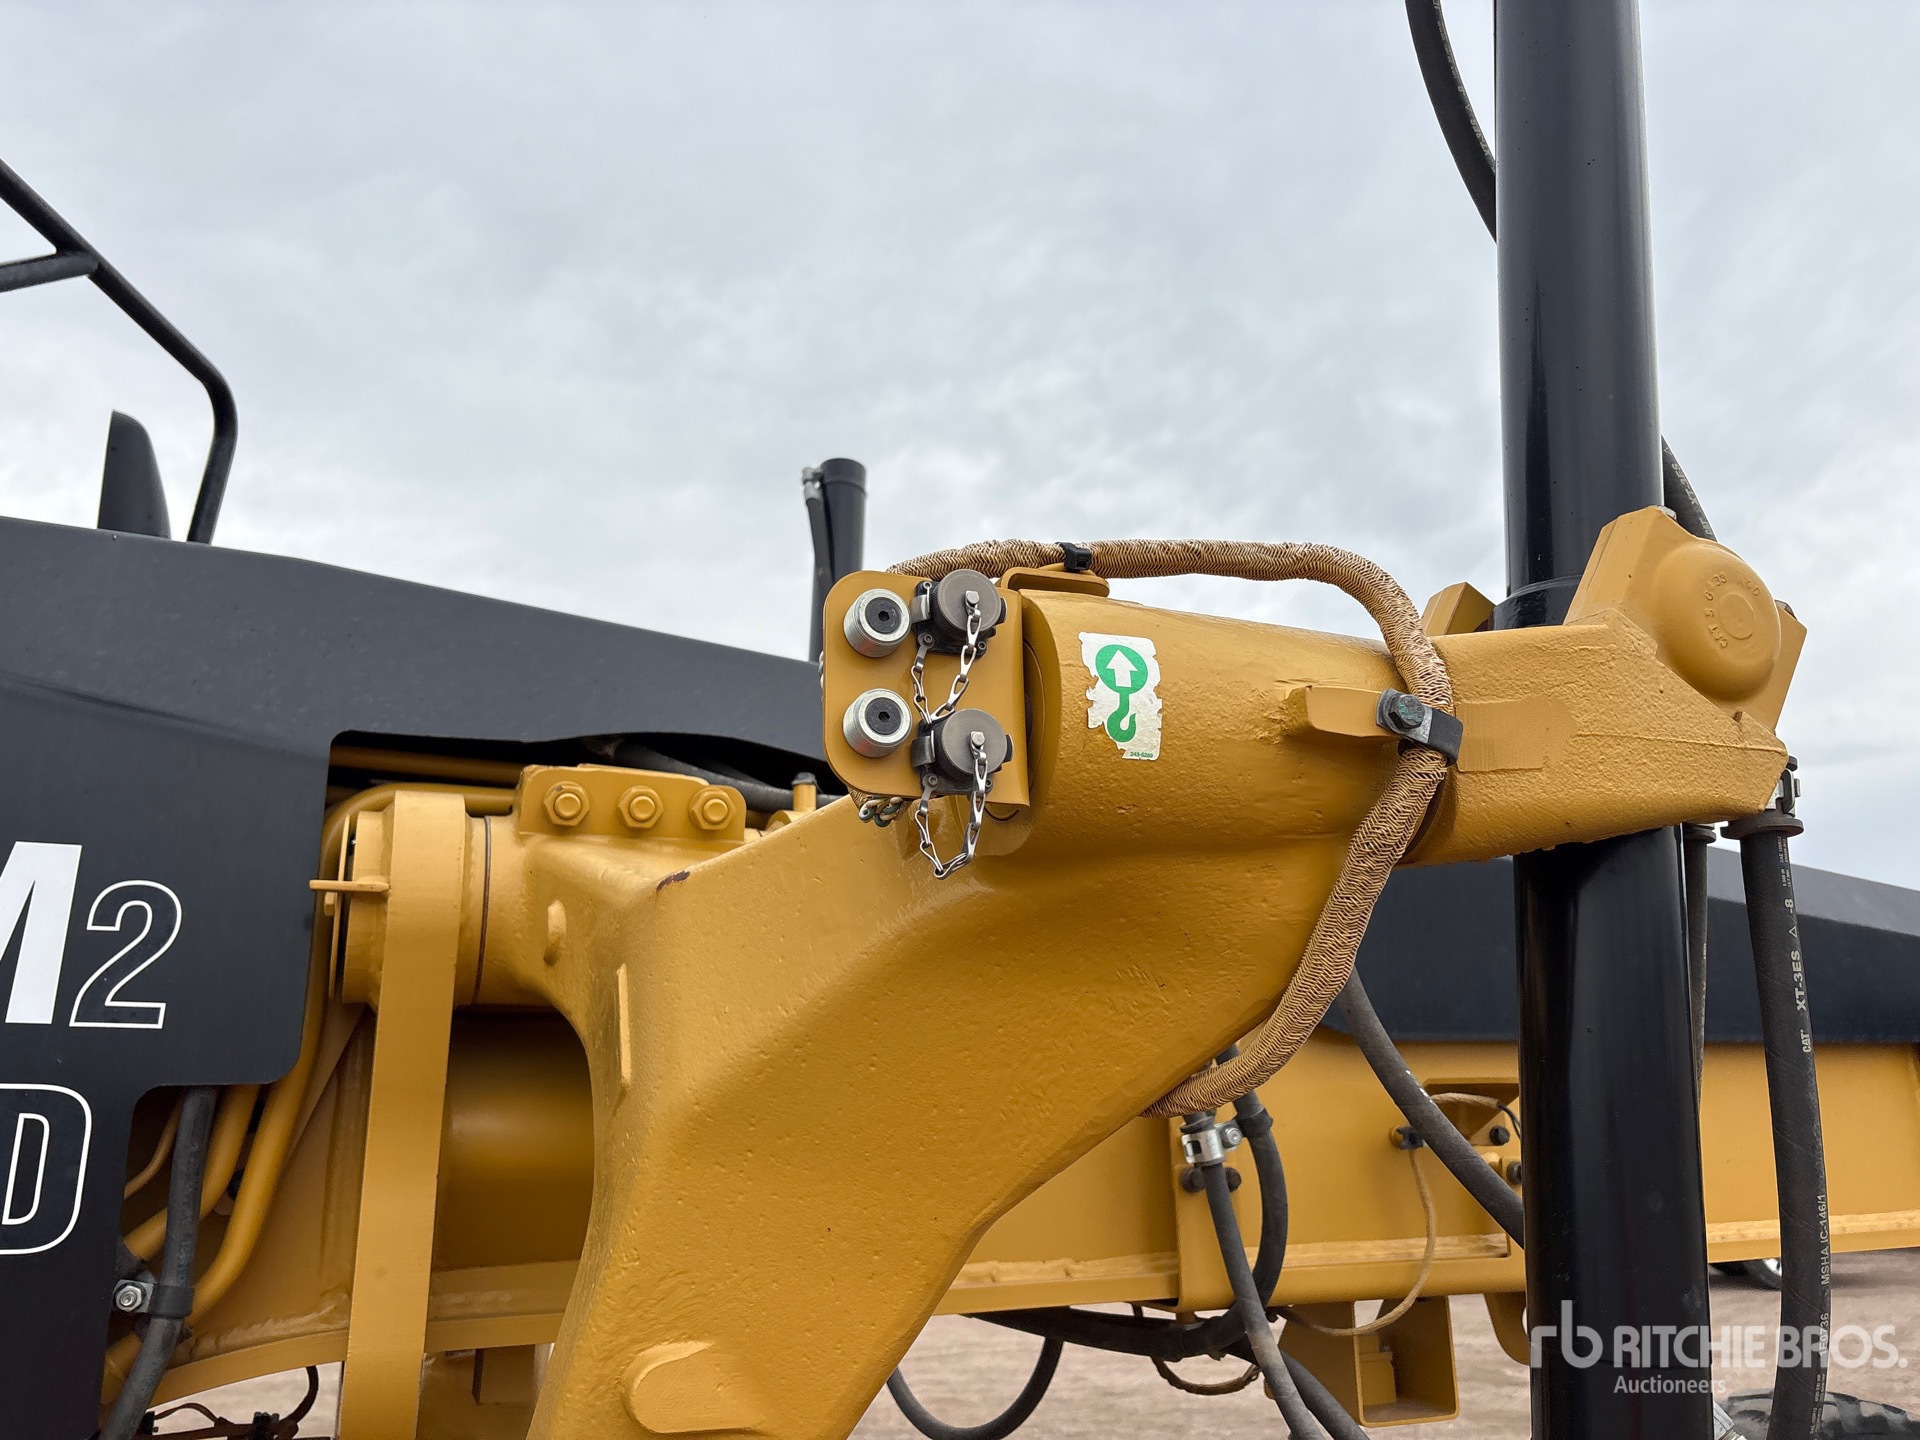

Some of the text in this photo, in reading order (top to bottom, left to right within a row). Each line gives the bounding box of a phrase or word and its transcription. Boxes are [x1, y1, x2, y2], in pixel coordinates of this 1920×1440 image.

[1790, 950, 1807, 1011] XT-3ES
[1800, 1033, 1812, 1053] CAT
[1817, 1194, 1830, 1285] MSHA IC-146/1
